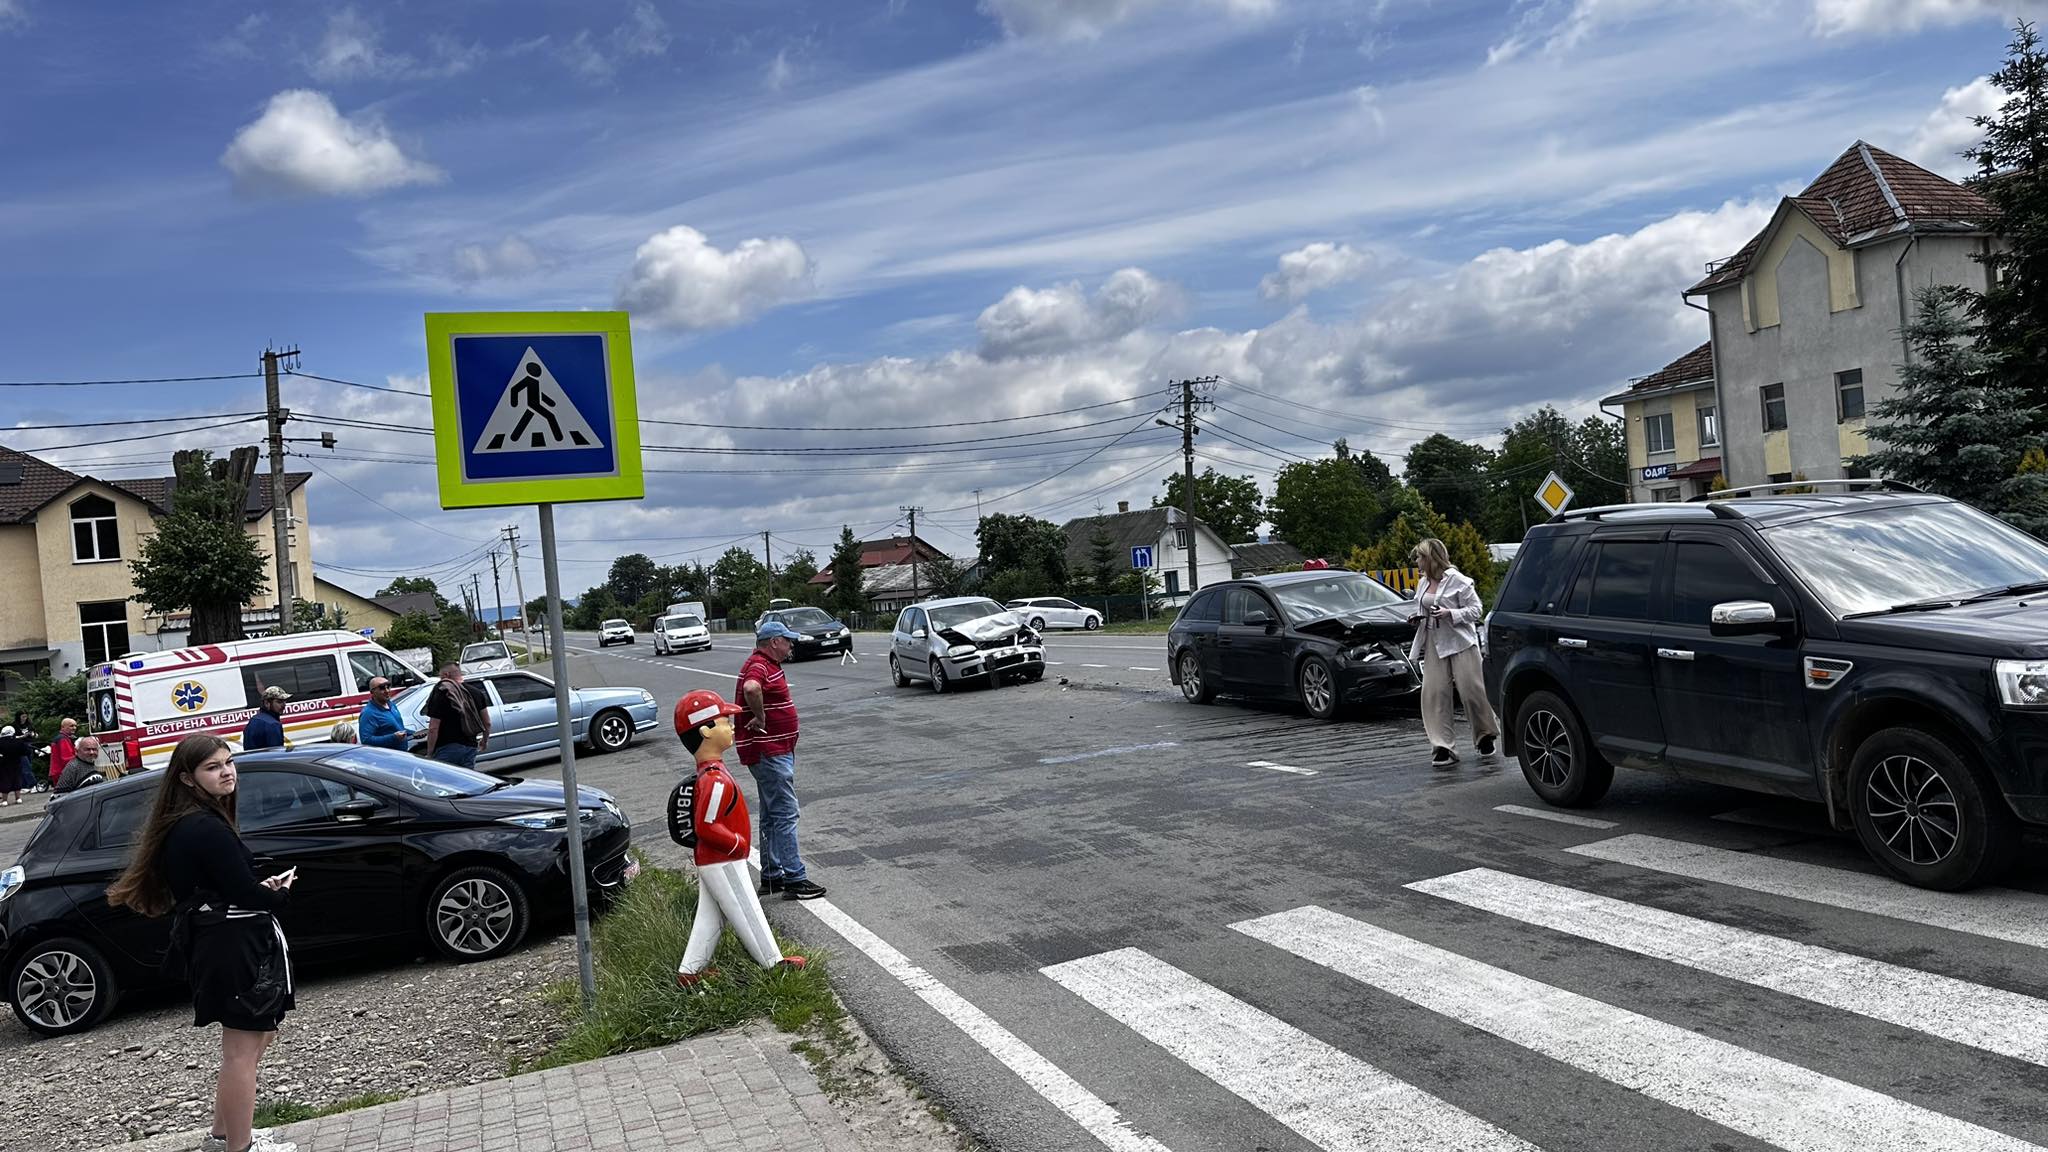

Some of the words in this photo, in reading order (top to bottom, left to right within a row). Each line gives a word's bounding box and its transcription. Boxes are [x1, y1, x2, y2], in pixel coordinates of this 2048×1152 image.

[1644, 467, 1667, 478] ОДЯГ
[146, 717, 207, 735] ЕКСТРЕНА
[211, 710, 258, 725] МЕДИЧН
[283, 700, 329, 714] ПОМОГА
[677, 786, 693, 838] УВАГА
